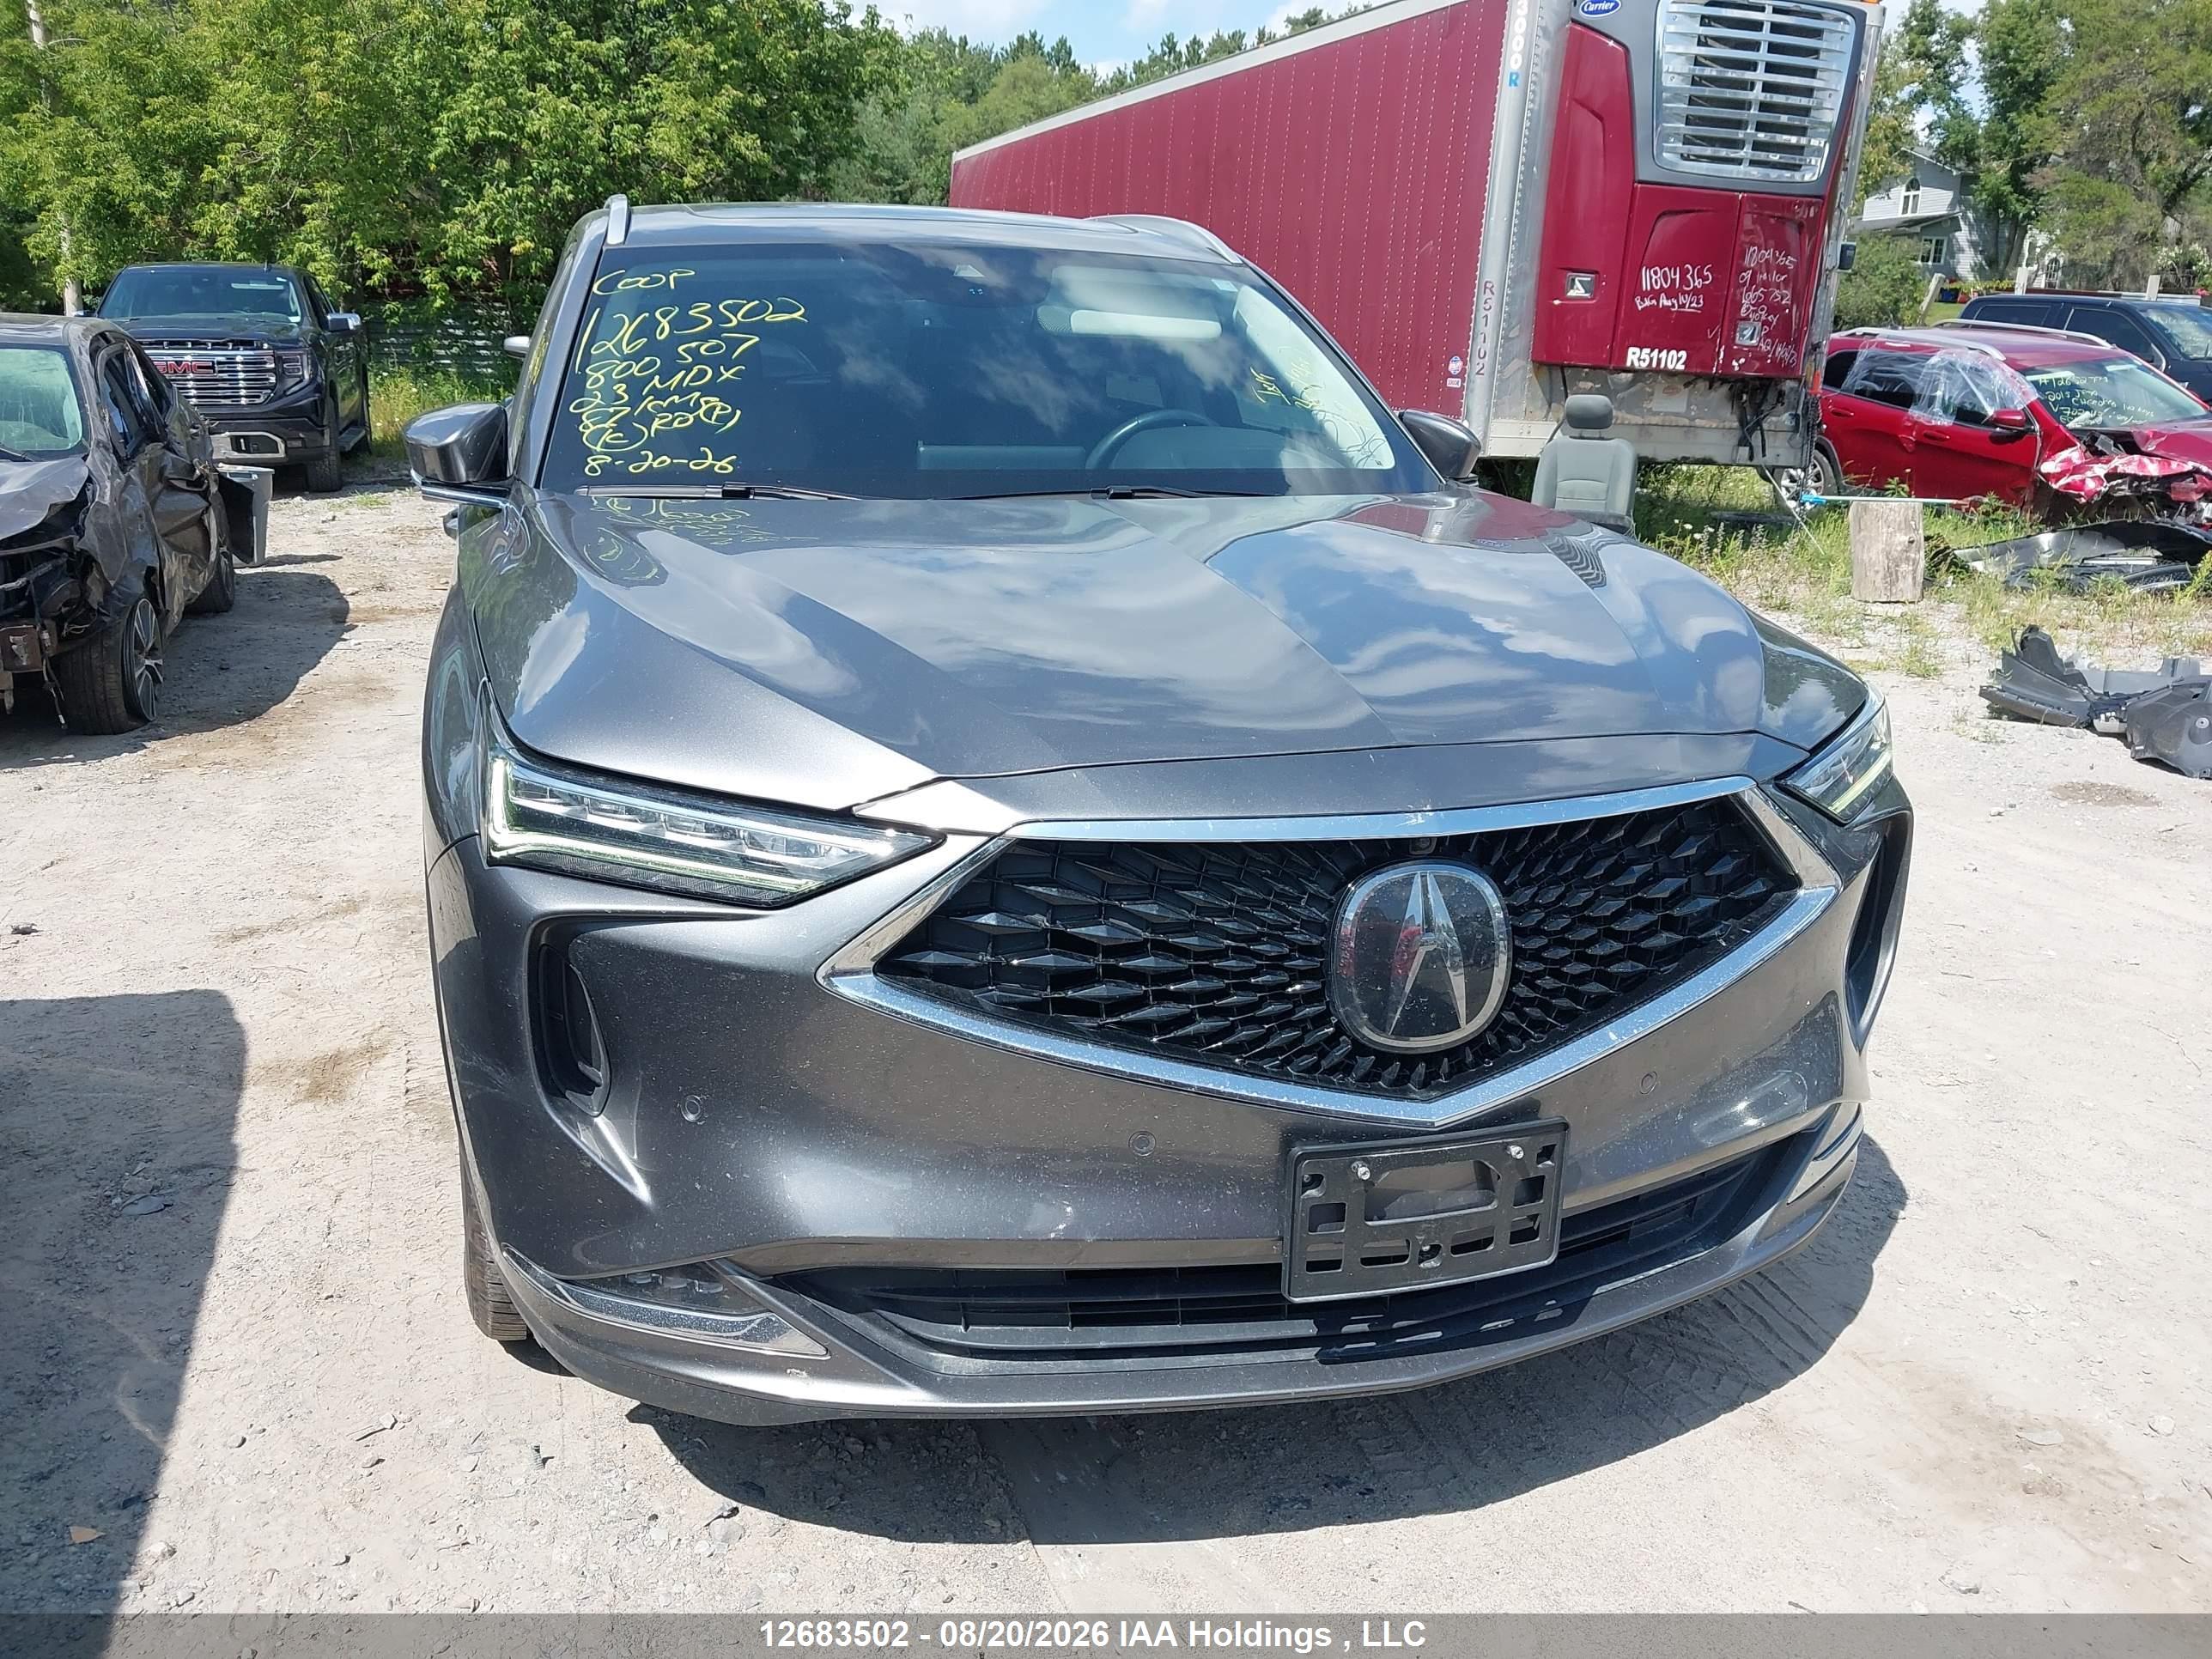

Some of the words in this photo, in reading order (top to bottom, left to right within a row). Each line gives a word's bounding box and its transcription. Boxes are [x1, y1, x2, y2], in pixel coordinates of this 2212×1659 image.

[1583, 1, 1615, 11] Carrier
[1642, 264, 1712, 291] 11804365
[575, 297, 808, 374] 12683502
[1475, 281, 1495, 375] R51102
[1626, 346, 1687, 370] R51102
[642, 366, 745, 395] MDX
[584, 447, 738, 476] 8-20-26
